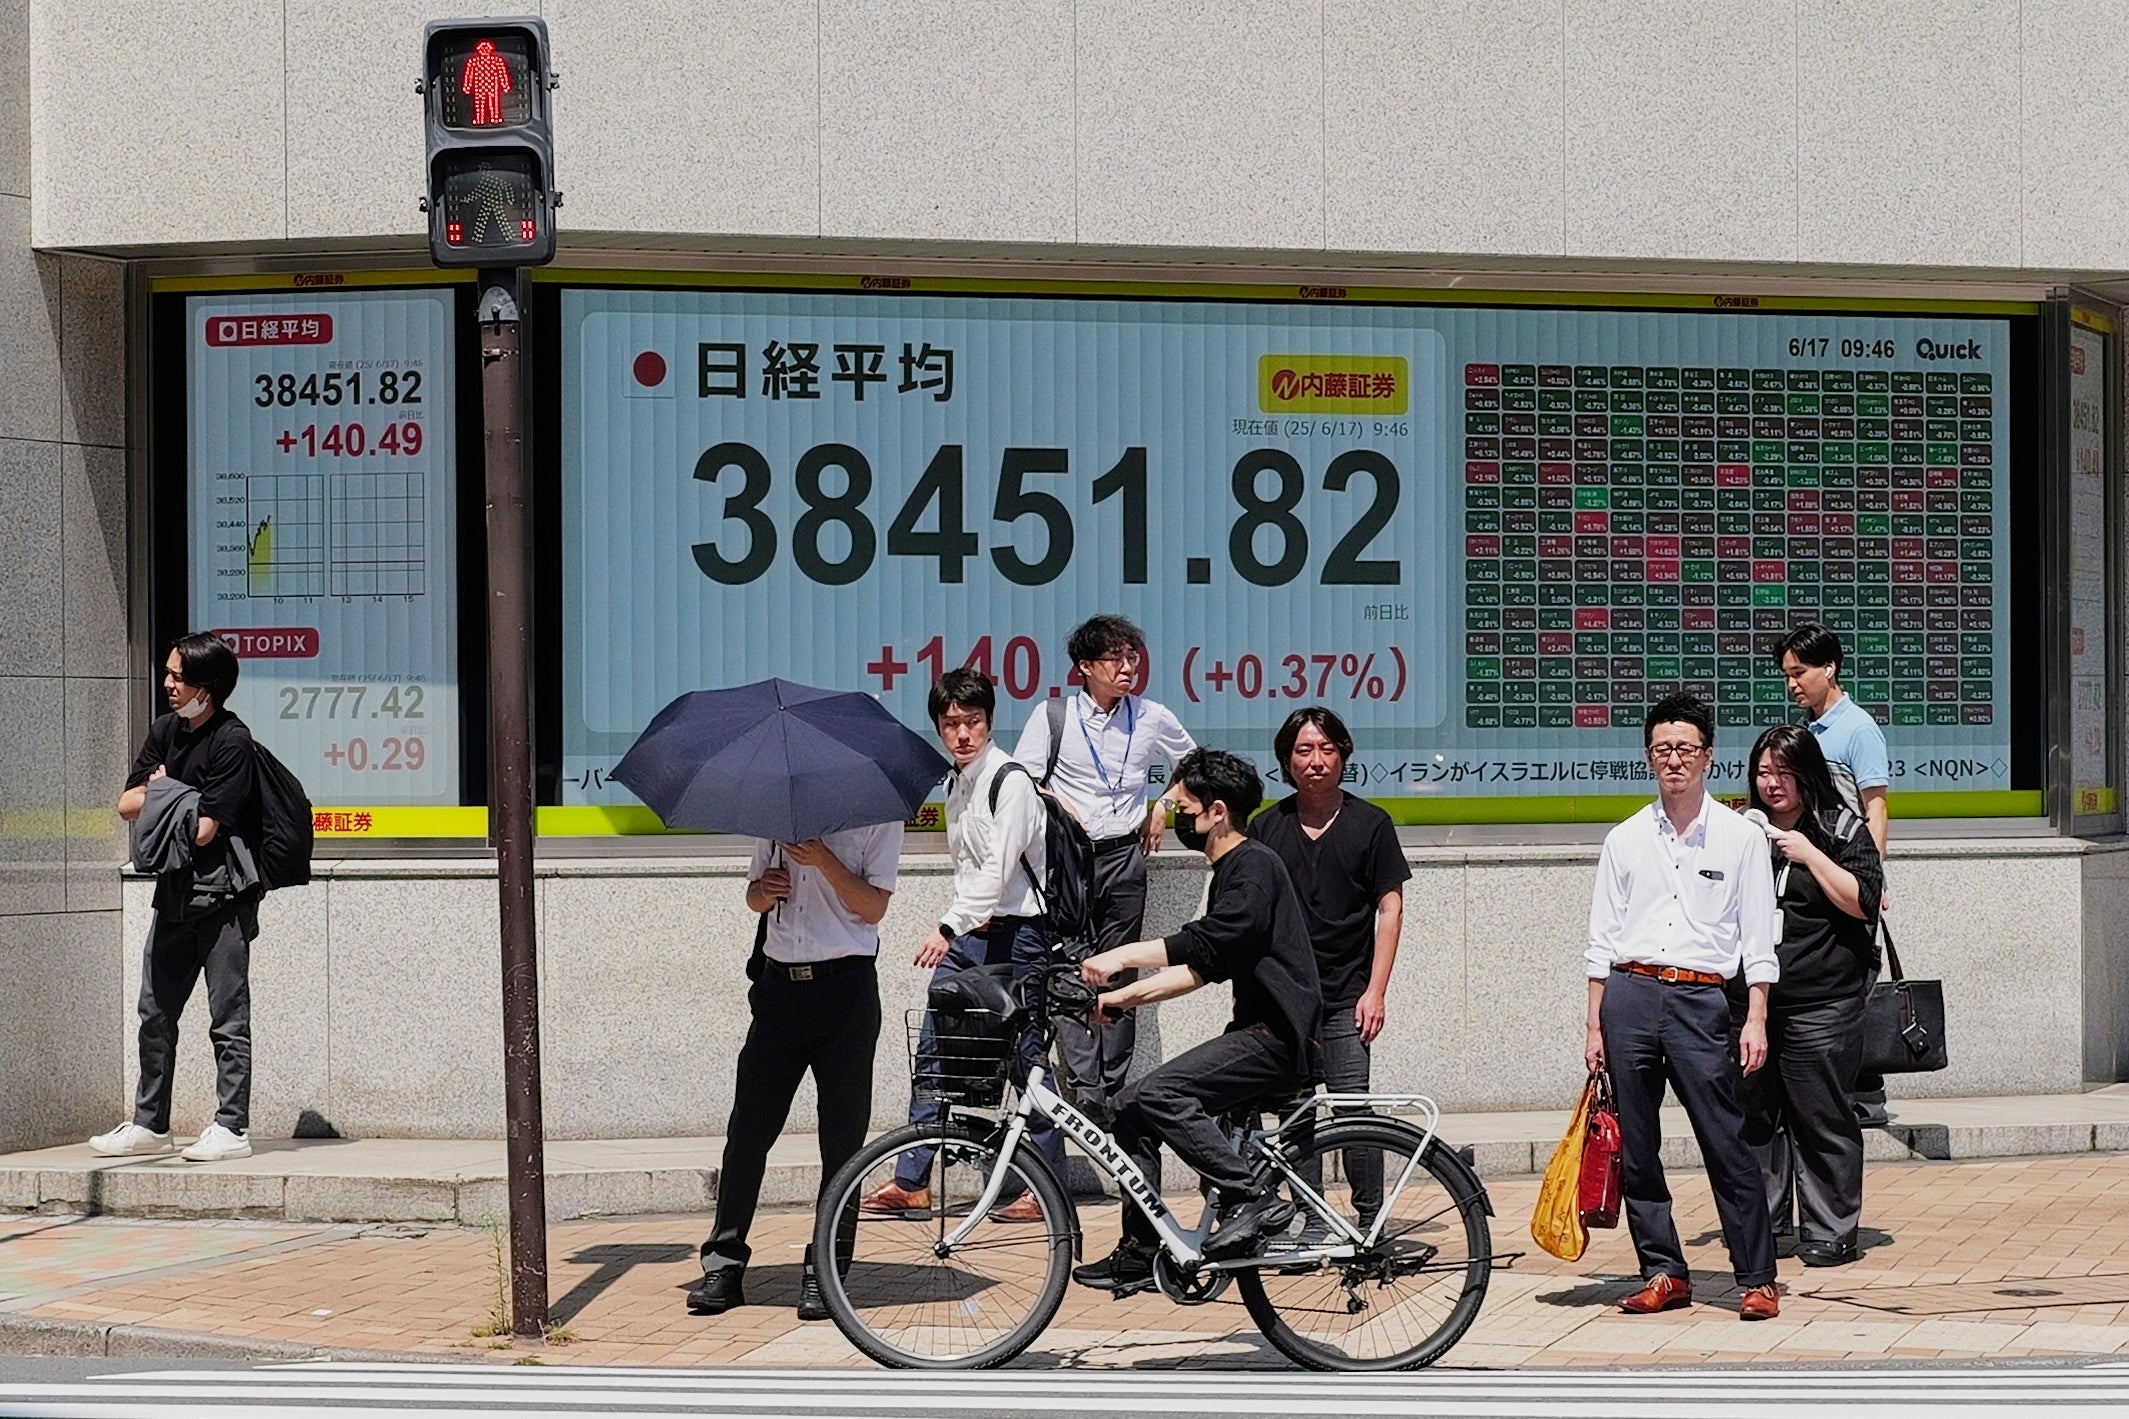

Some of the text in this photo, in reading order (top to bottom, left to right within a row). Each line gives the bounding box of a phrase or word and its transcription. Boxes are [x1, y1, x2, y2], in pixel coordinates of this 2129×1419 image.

[241, 319, 320, 340] 日経平均
[1788, 337, 1895, 359] 6/17 09:46
[1916, 338, 1982, 361] Quick
[698, 339, 954, 402] 日経平均
[254, 370, 422, 408] 38451.82
[1301, 372, 1396, 399] 内藤証券
[276, 422, 423, 458] +140.49
[1232, 419, 1278, 436] 現在値
[1374, 422, 1408, 437] 9:46
[691, 442, 1401, 585] 38451.82
[1474, 546, 1498, 554] +2.11%
[1363, 605, 1409, 621] 前日比
[244, 634, 306, 652] TOPIX
[1182, 646, 1406, 702] (+0.37%)
[279, 686, 424, 720] 2777.42
[324, 736, 425, 771] +0.29
[312, 812, 372, 832] 藤証券
[1052, 1102, 1168, 1219] FRONTUM
